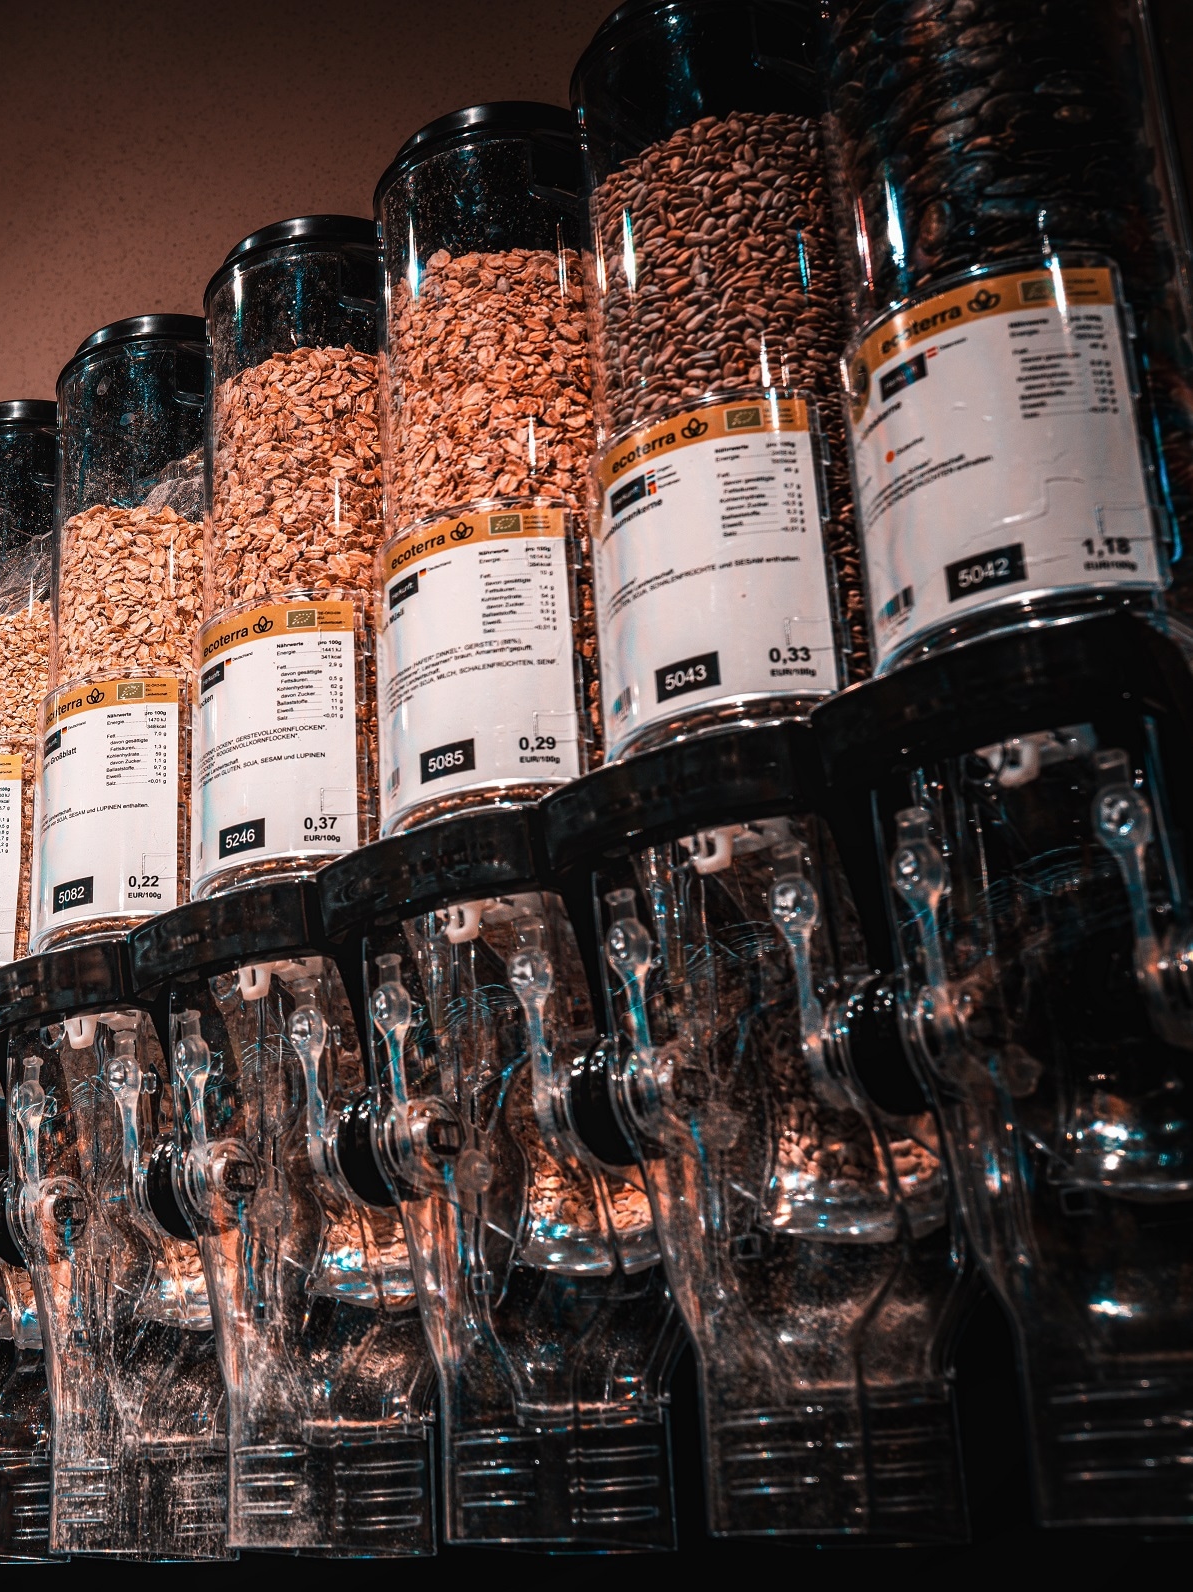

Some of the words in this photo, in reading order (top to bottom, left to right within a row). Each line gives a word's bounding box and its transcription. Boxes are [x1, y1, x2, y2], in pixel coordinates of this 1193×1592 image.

[612, 432, 676, 474] ecoterra
[391, 534, 445, 570] ecoterra
[1082, 536, 1131, 558] 1,18
[957, 557, 1010, 588] 5042
[203, 627, 249, 657] ecoterra
[769, 646, 811, 665] 0,33
[665, 664, 707, 691] 5043
[519, 736, 556, 752] 0,29
[243, 760, 259, 768] SOJA,
[260, 755, 282, 764] SESAM
[428, 750, 465, 772] 5085
[68, 810, 86, 818] SESAM
[97, 804, 122, 812] LUPINEN
[304, 817, 337, 832] 0,37
[225, 828, 255, 849] 5246
[128, 875, 159, 889] 0,22
[58, 886, 85, 904] 5082
